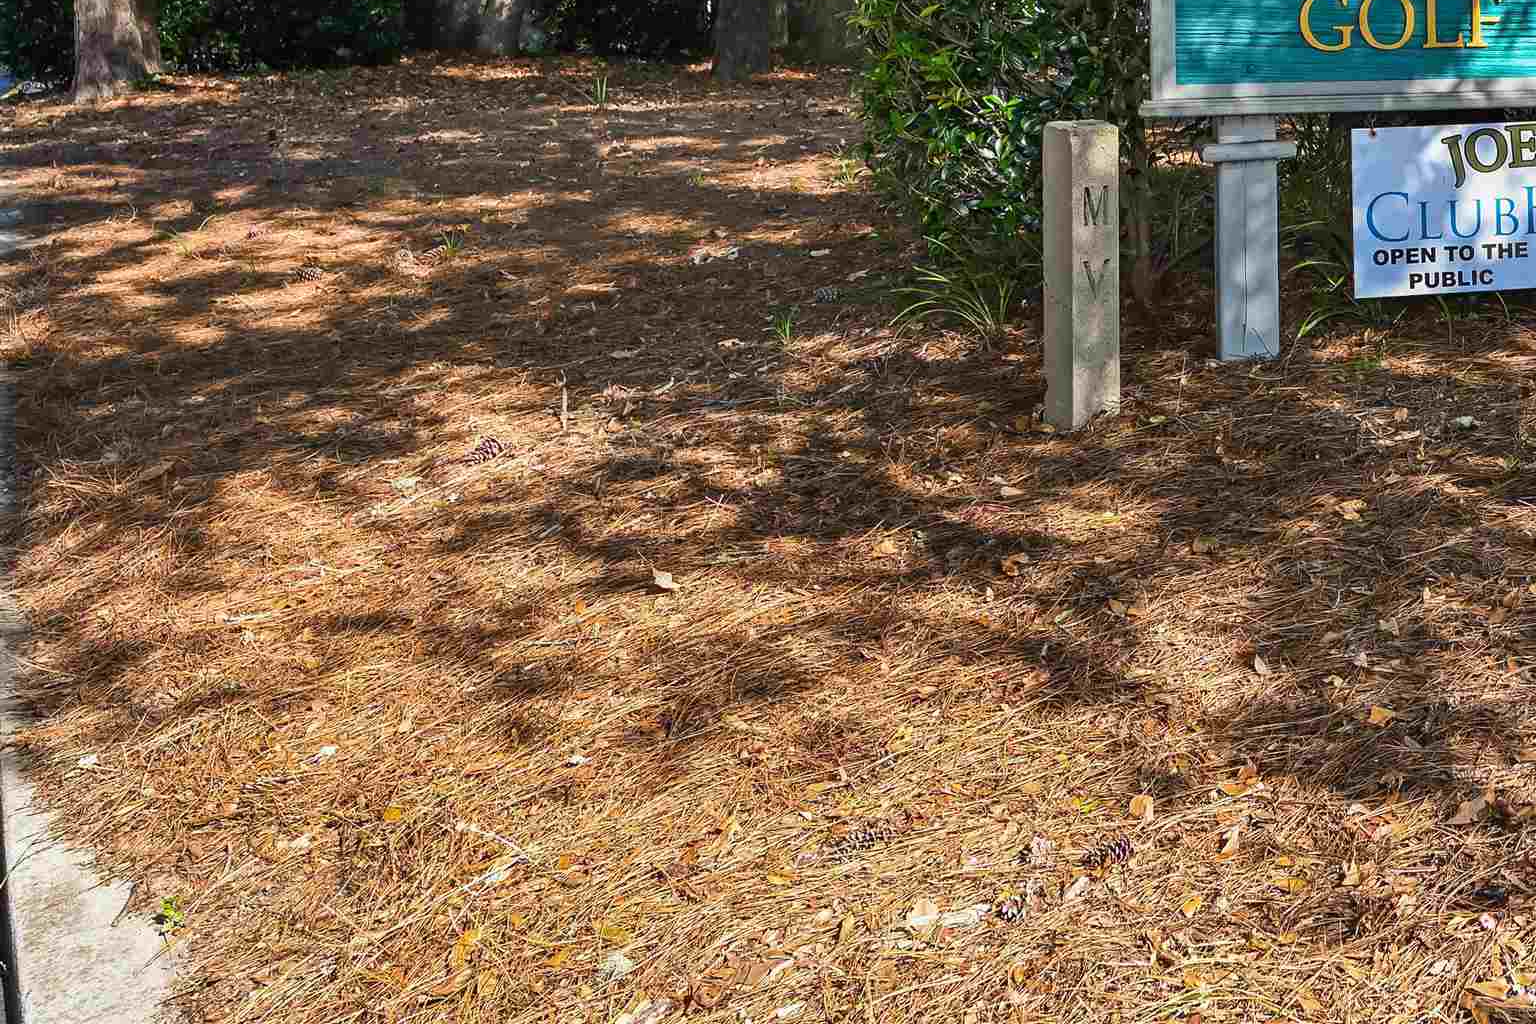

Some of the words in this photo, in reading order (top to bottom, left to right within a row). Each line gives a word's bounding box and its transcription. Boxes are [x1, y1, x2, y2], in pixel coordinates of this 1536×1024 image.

[1372, 247, 1437, 267] OPEN
[1443, 245, 1475, 263] TO
[1482, 241, 1529, 260] THE
[1408, 268, 1494, 291] PUBLIC
